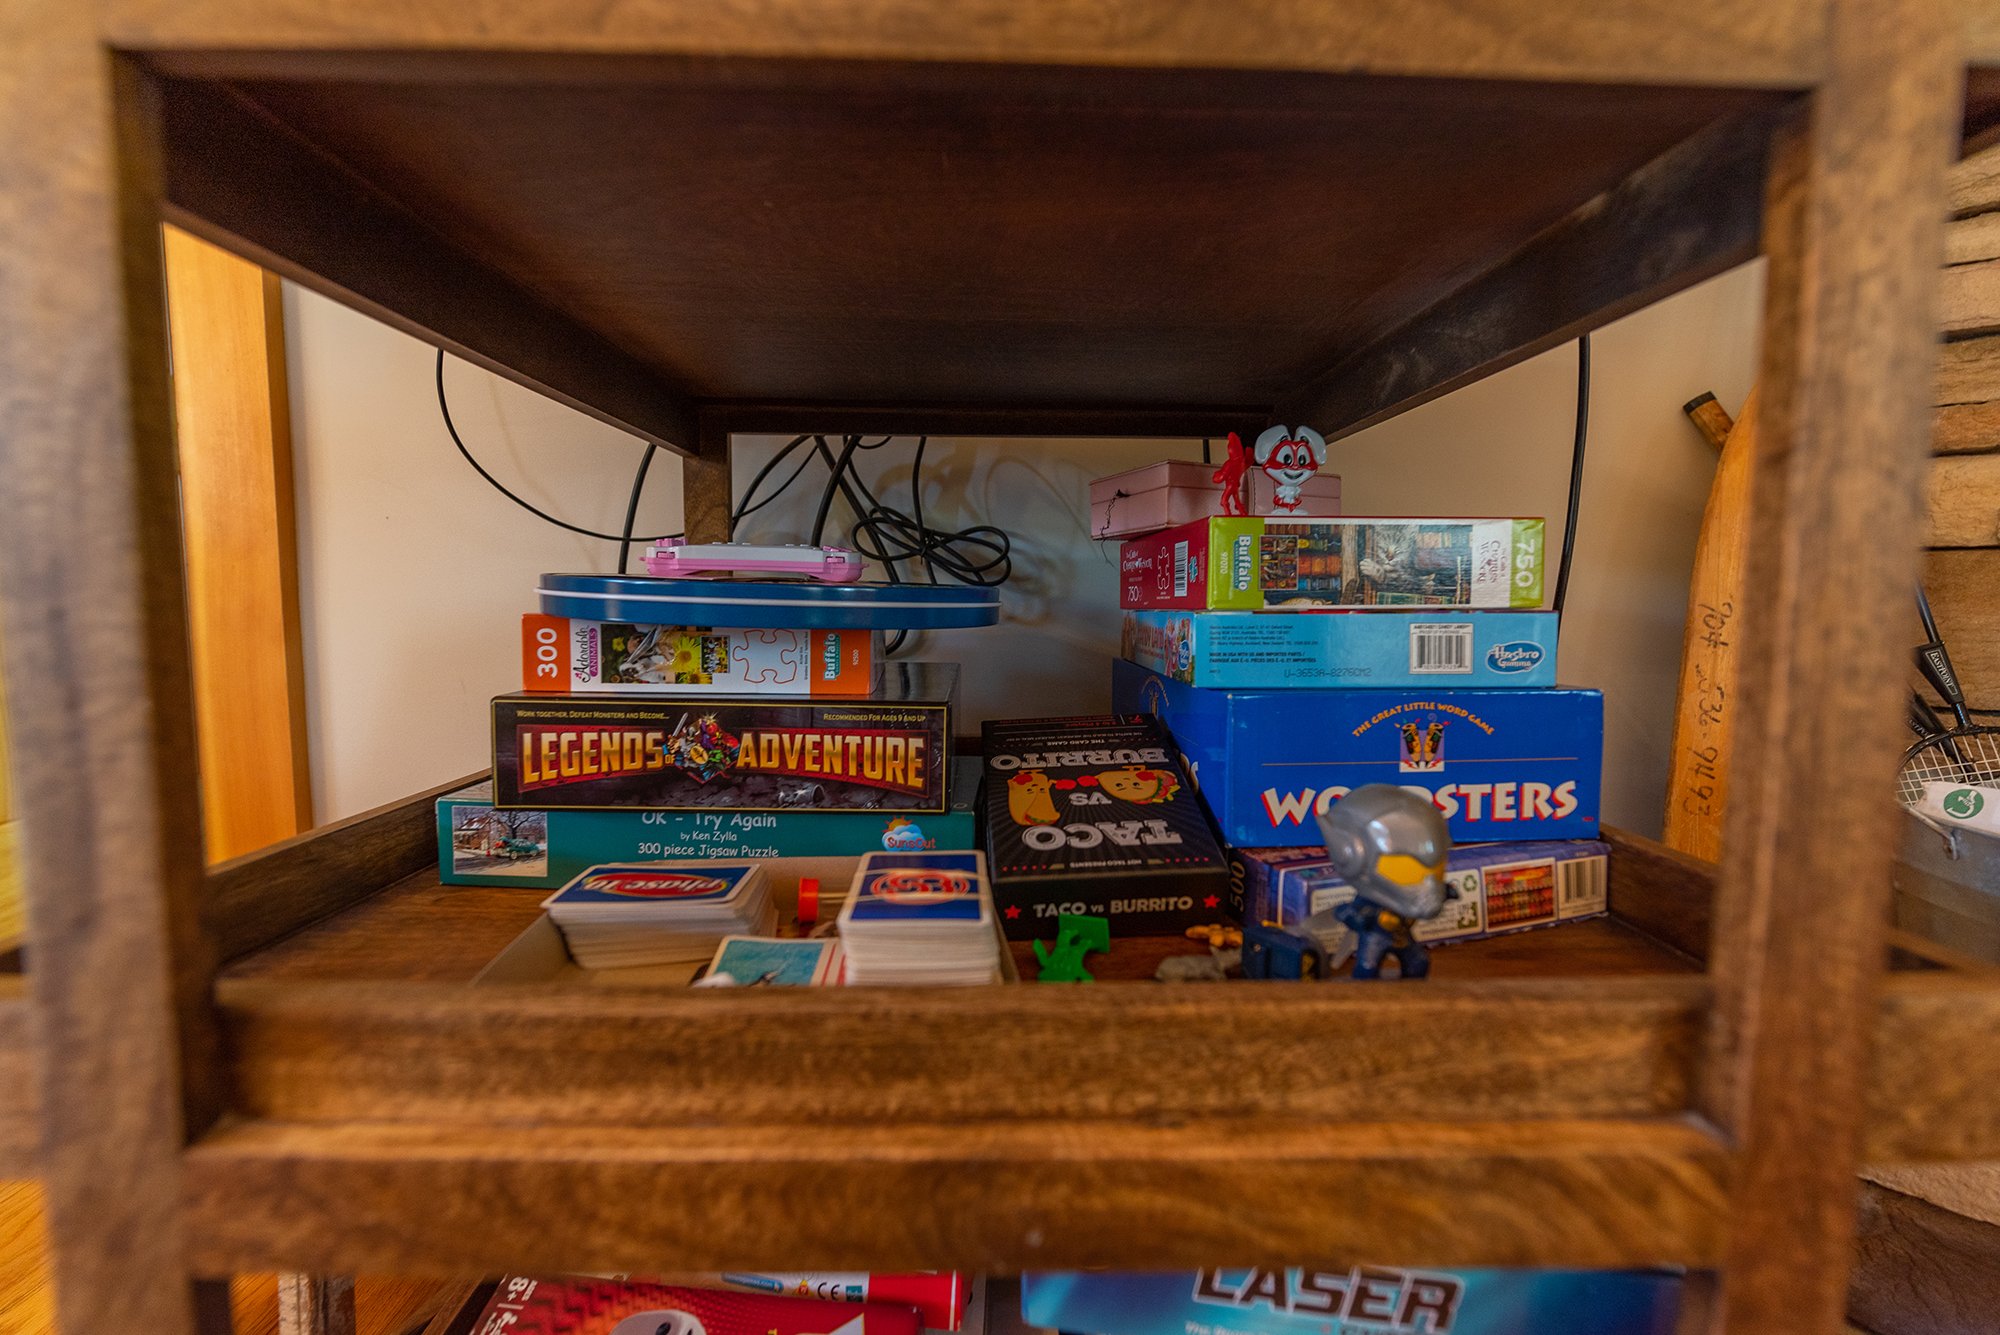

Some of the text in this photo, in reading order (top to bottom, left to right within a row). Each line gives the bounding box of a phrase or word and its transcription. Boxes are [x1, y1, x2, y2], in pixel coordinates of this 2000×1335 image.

[1238, 535, 1252, 591] Buffalo
[1515, 538, 1536, 588] 750
[536, 627, 558, 679] 300
[573, 625, 591, 683] Adorable
[590, 628, 598, 674] ANIMALS
[824, 633, 836, 680] Buffalo
[1489, 645, 1540, 661] Hasbro
[569, 711, 593, 719] DEFEAT
[593, 711, 625, 719] MONSTERS
[823, 713, 868, 721] RECOMMENDED
[868, 713, 881, 721] FOR
[881, 714, 897, 722] AGES
[917, 714, 926, 722] UP
[1352, 701, 1496, 737] THE GREAT LITTLE WORD GAME
[522, 732, 925, 788] LEGENDS OF ADVENTURE
[990, 748, 1169, 770] BURRITO
[680, 831, 738, 843] by Ken Zylla
[730, 812, 777, 831] Again
[1021, 819, 1183, 850] TACO
[638, 843, 780, 859] 300 piece Jigsaw Puzzle
[887, 836, 936, 850] SunsOut
[1033, 901, 1087, 918] TACO
[1110, 896, 1194, 915] BURRITO
[1192, 1266, 1465, 1334] LASER
